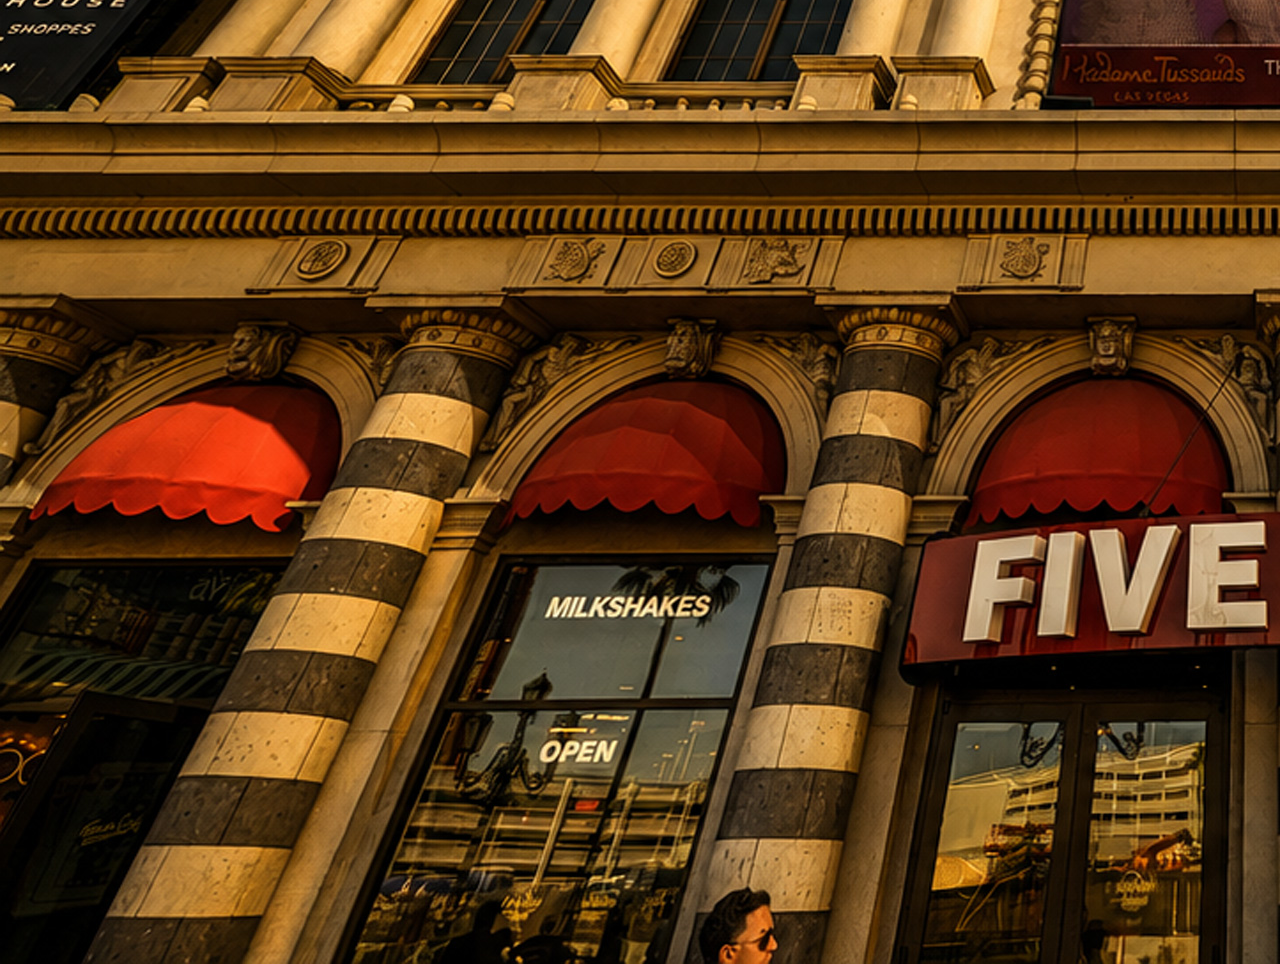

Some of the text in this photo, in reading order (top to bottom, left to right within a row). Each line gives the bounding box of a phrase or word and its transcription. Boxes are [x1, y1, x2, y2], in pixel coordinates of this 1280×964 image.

[7, 23, 96, 35] SHOPPES
[1153, 53, 1246, 84] Tussauds
[962, 521, 1268, 643] FIVE
[544, 595, 712, 619] MILKSHAKES
[539, 739, 619, 764] OPEN
